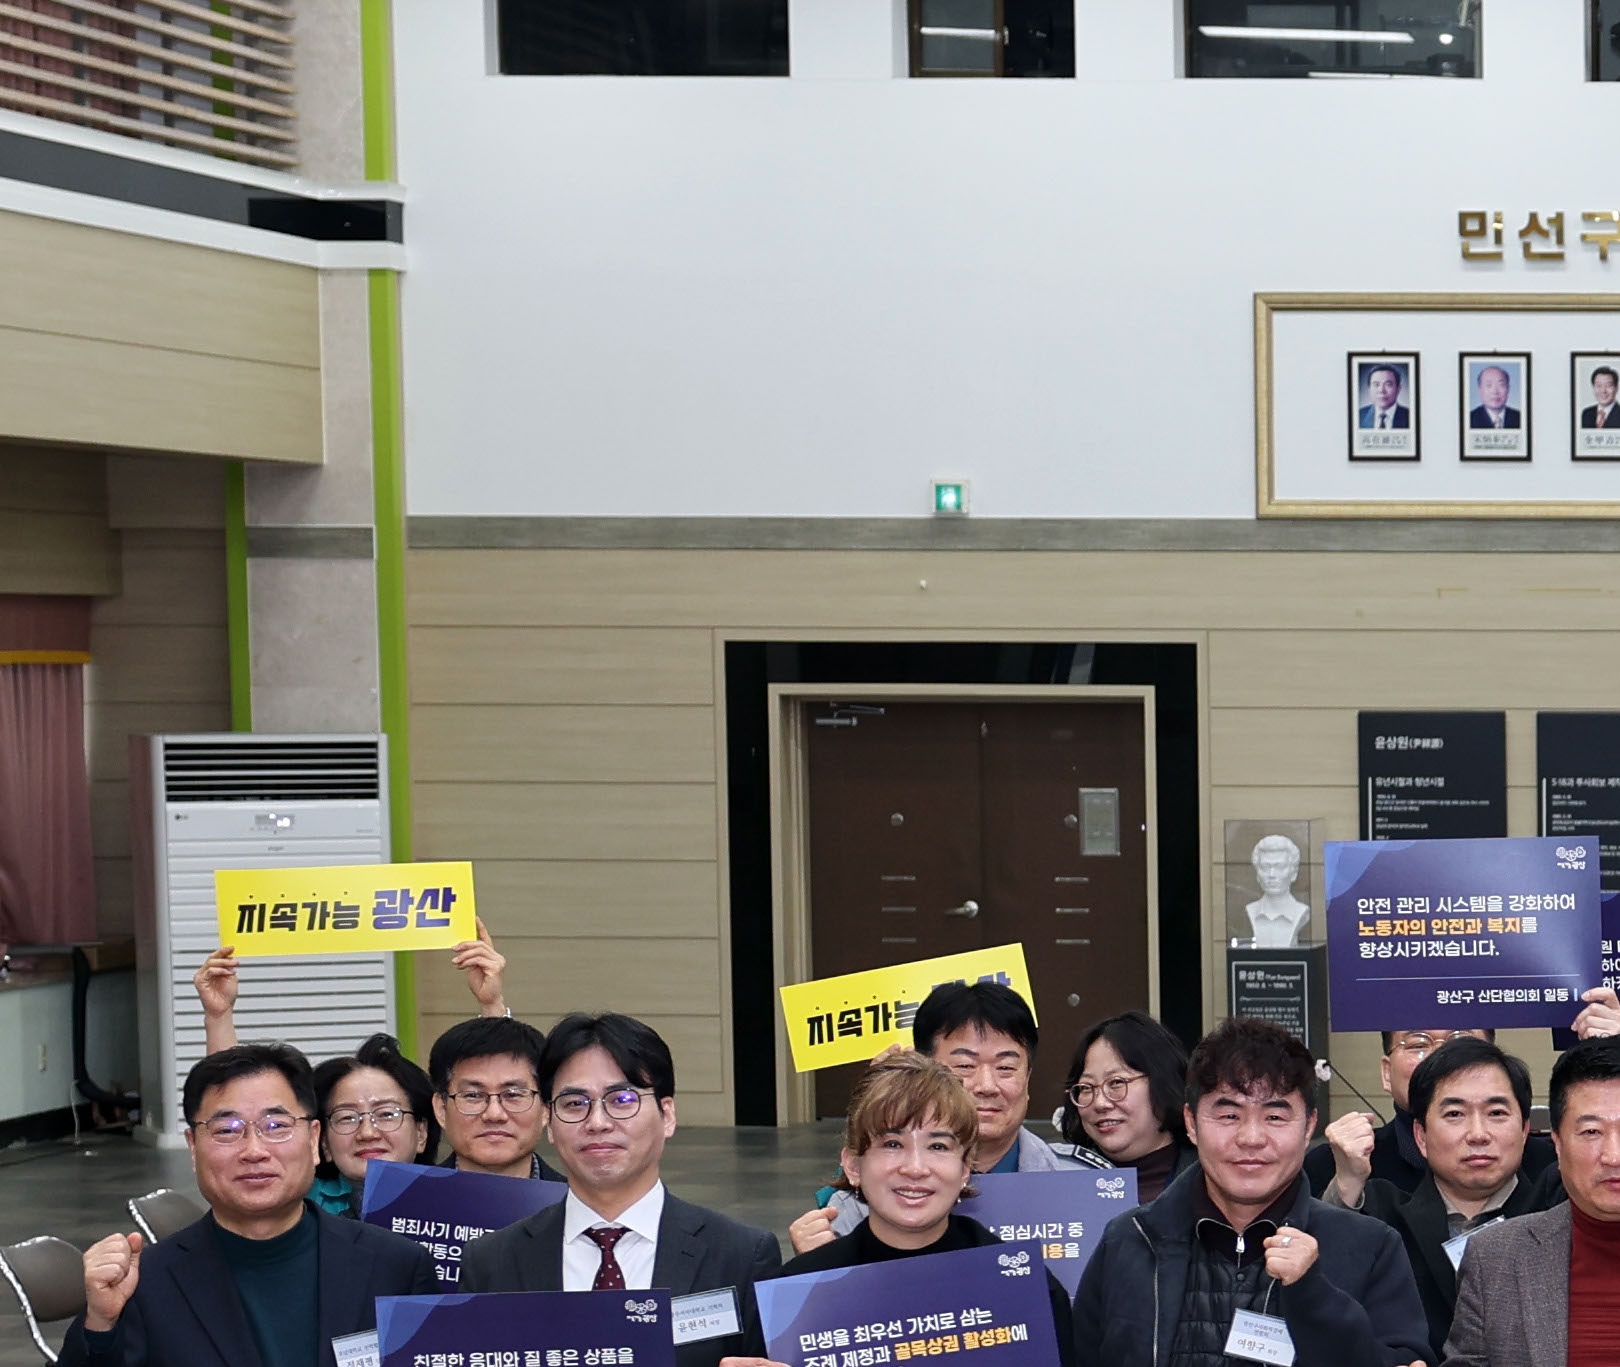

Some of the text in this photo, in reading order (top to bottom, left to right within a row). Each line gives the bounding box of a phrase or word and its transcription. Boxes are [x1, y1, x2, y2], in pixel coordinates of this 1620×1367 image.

[236, 887, 457, 934] 지속가능 광산
[1357, 893, 1576, 915] 안전 관리 시스템을 강화하여
[1358, 916, 1537, 937] 노동자의 안전과 복지를
[1359, 939, 1500, 959] 향상시키겠습니다.
[1437, 986, 1570, 1005] 광산구 산단협의회 일동
[391, 1216, 495, 1242] 범죄사기 예방
[1000, 1222, 1084, 1240] 점심시간 중
[800, 1305, 993, 1353] 민생을 최우선 가치로 삼는
[894, 1335, 961, 1362] 골목상권
[962, 1324, 1028, 1350] 활성화에
[545, 1349, 579, 1367] 좋은
[583, 1348, 634, 1366] 상품을
